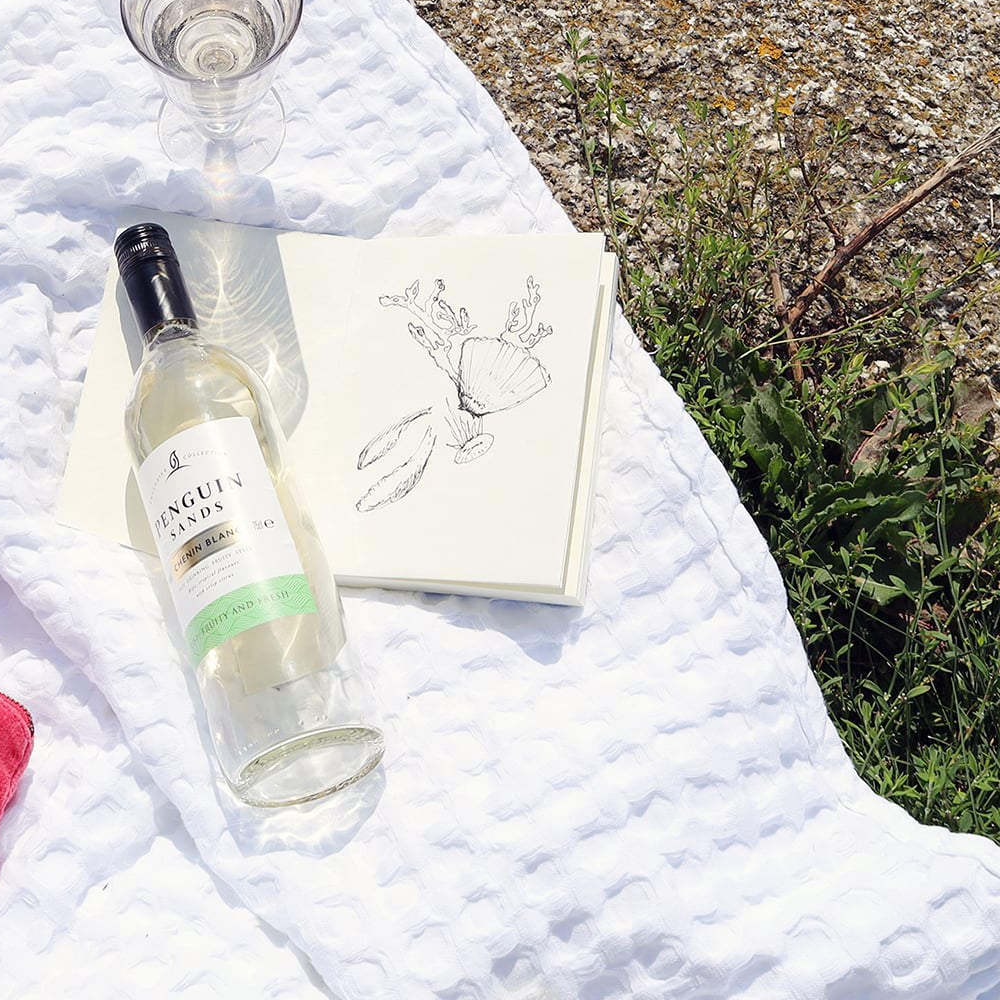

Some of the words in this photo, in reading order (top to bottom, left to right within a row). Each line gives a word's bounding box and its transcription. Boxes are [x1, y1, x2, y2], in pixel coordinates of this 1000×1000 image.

[154, 472, 244, 538] PENGUIN
[170, 500, 224, 542] SANDS
[174, 543, 203, 572] CHENIN
[205, 527, 241, 548] BLANC
[200, 612, 229, 635] FRUITY
[232, 601, 254, 616] AND
[257, 591, 290, 606] FRESH
